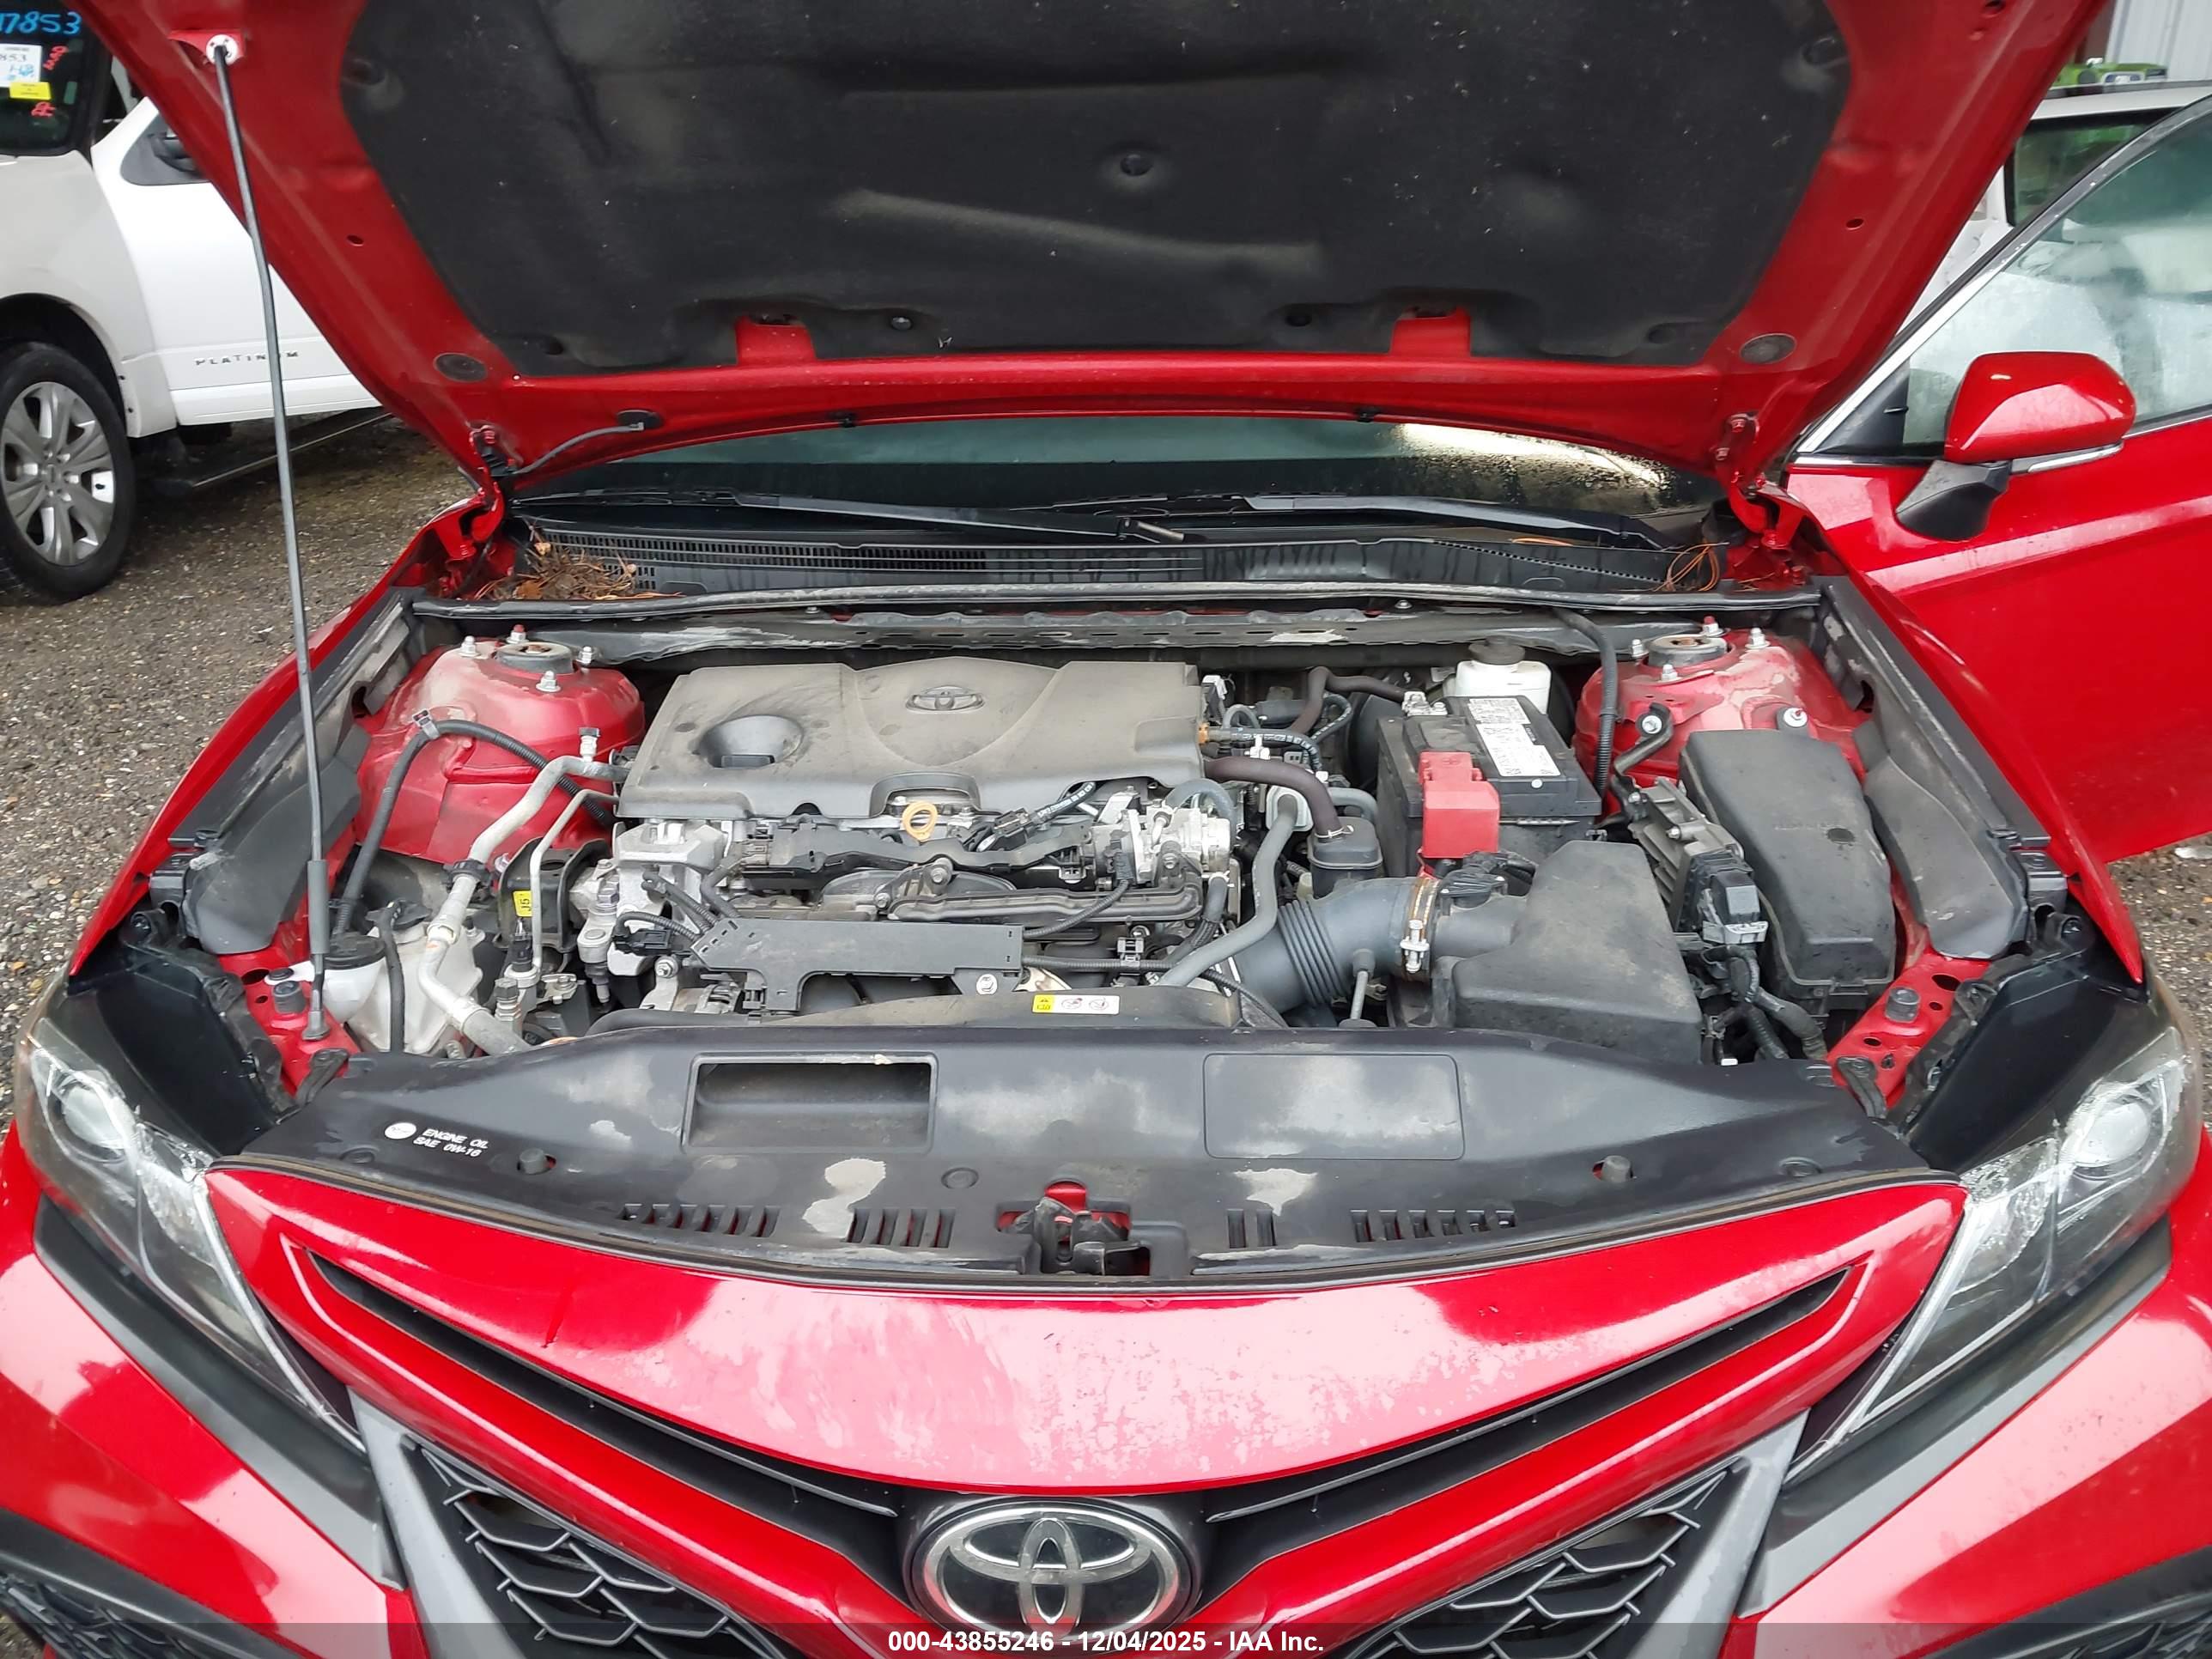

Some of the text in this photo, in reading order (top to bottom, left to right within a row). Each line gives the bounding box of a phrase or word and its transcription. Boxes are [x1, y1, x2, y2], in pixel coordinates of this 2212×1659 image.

[195, 351, 298, 366] PLATINM
[413, 1136, 483, 1158] SAE 0W-16
[422, 1128, 467, 1144] ENGINE
[470, 1139, 489, 1149] OIL
